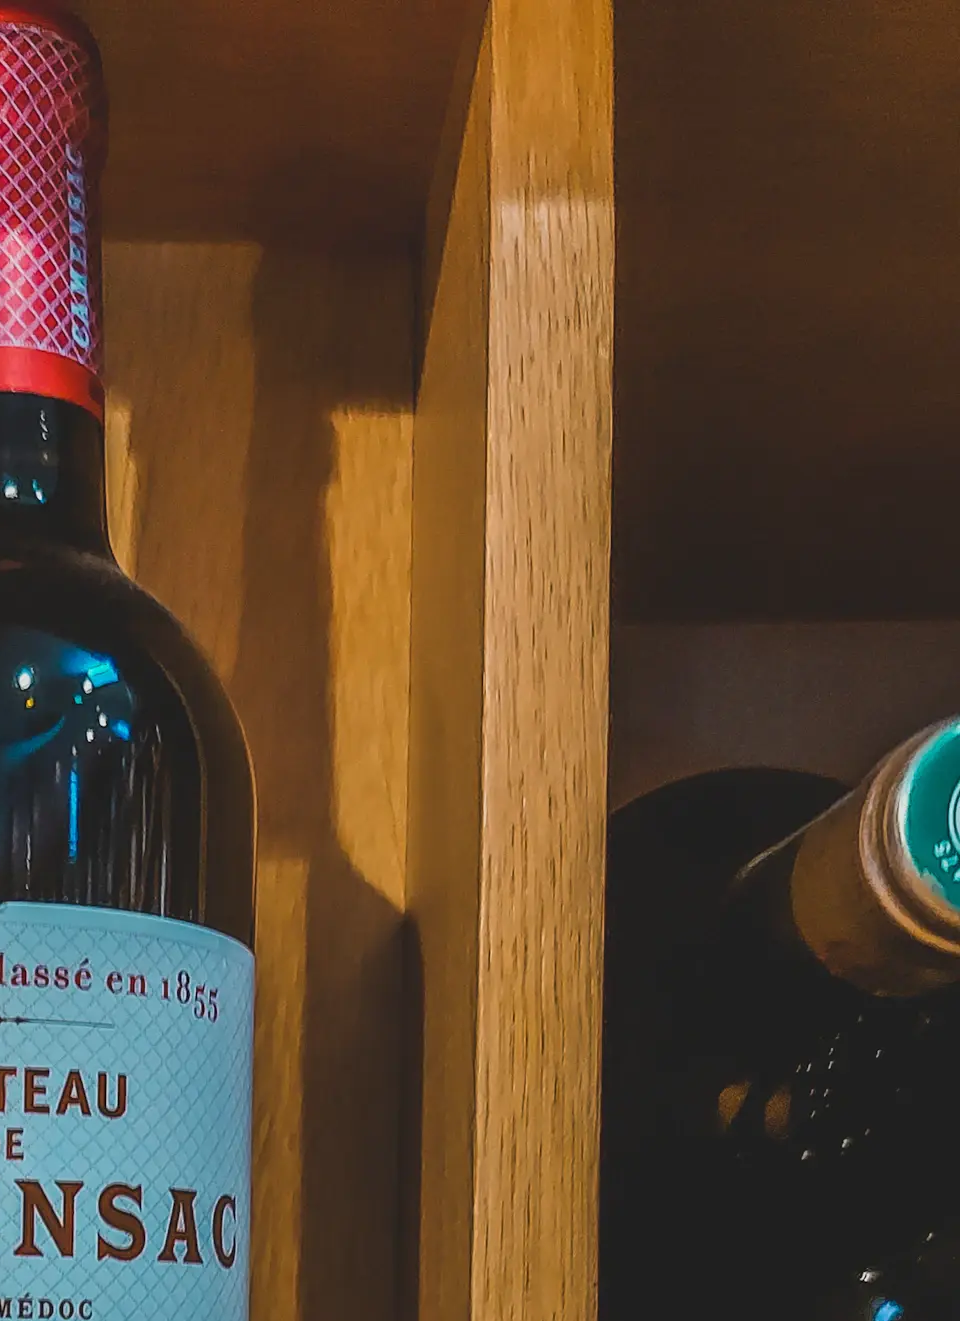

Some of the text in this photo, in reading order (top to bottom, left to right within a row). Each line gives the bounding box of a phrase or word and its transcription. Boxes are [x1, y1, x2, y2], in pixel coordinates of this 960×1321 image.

[66, 143, 90, 350] CAMENSAC
[105, 970, 148, 997] en
[160, 969, 220, 1024] 1855
